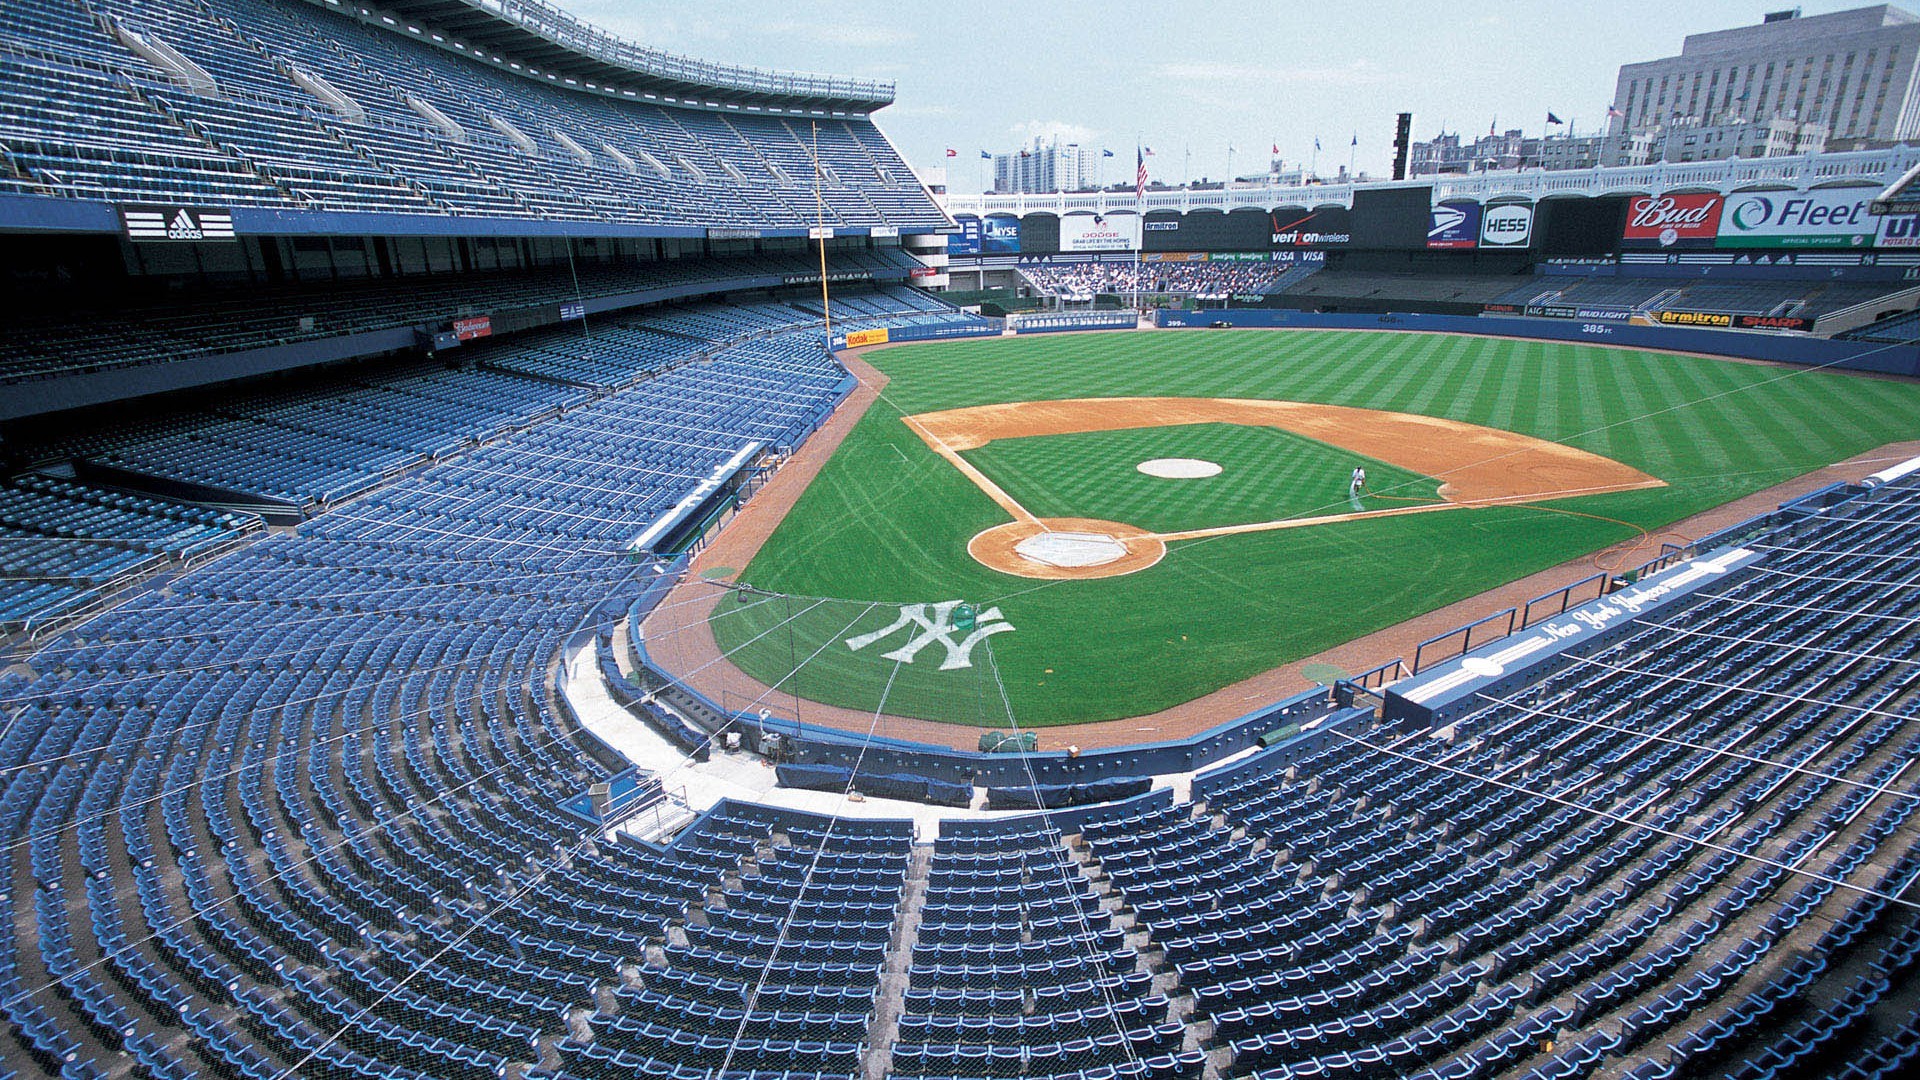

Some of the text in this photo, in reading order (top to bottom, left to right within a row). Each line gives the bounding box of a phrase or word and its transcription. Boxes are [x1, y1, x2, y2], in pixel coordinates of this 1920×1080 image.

[1631, 198, 1717, 227] Bud
[1776, 199, 1866, 225] Fleet
[1486, 218, 1527, 232] HESS
[168, 227, 203, 239] adidas
[993, 227, 1017, 236] NYSE
[1272, 230, 1320, 246] verizon
[1272, 252, 1294, 260] VISA
[1303, 252, 1324, 260] VISA
[1528, 307, 1542, 315] AIG
[1599, 311, 1629, 319] LIGHT
[1662, 311, 1730, 323] Armitron
[1742, 316, 1804, 327] SHARP
[1582, 324, 1604, 333] 385
[847, 333, 868, 346] Kodak
[1540, 587, 1671, 642] New York Yankees
